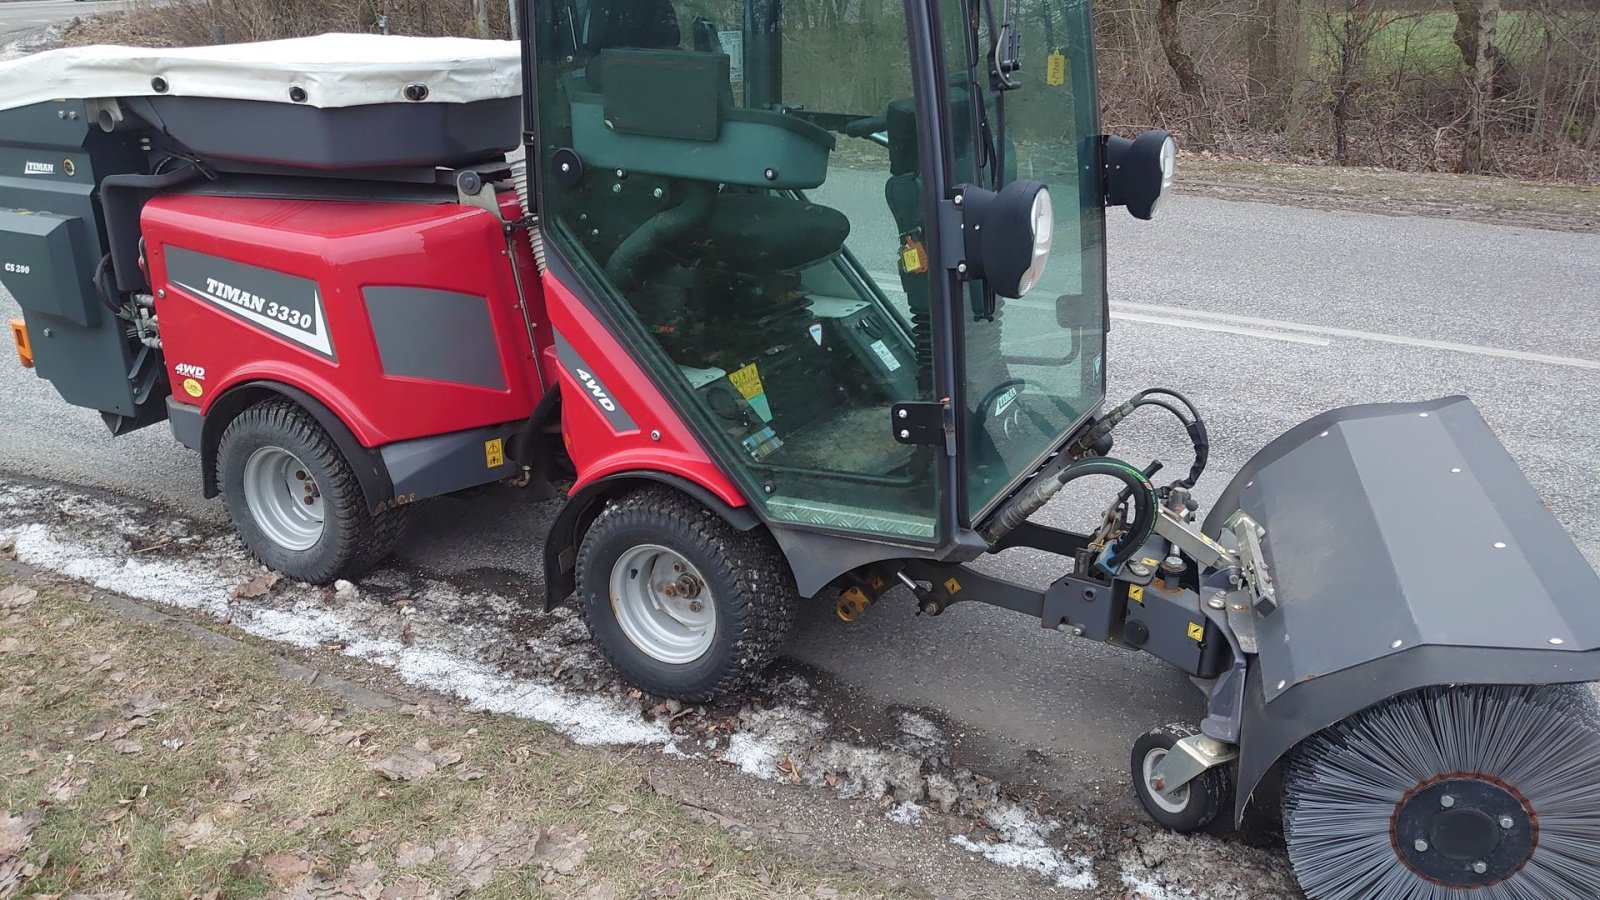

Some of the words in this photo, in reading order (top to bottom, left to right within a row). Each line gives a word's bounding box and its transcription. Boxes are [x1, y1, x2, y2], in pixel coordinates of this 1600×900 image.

[28, 162, 54, 172] TIMAN
[5, 262, 15, 273] CS
[16, 264, 30, 274] 200
[206, 277, 265, 313] TIMAN
[266, 302, 312, 329] 3330
[175, 362, 205, 376] 4WD
[576, 368, 616, 411] 4WD
